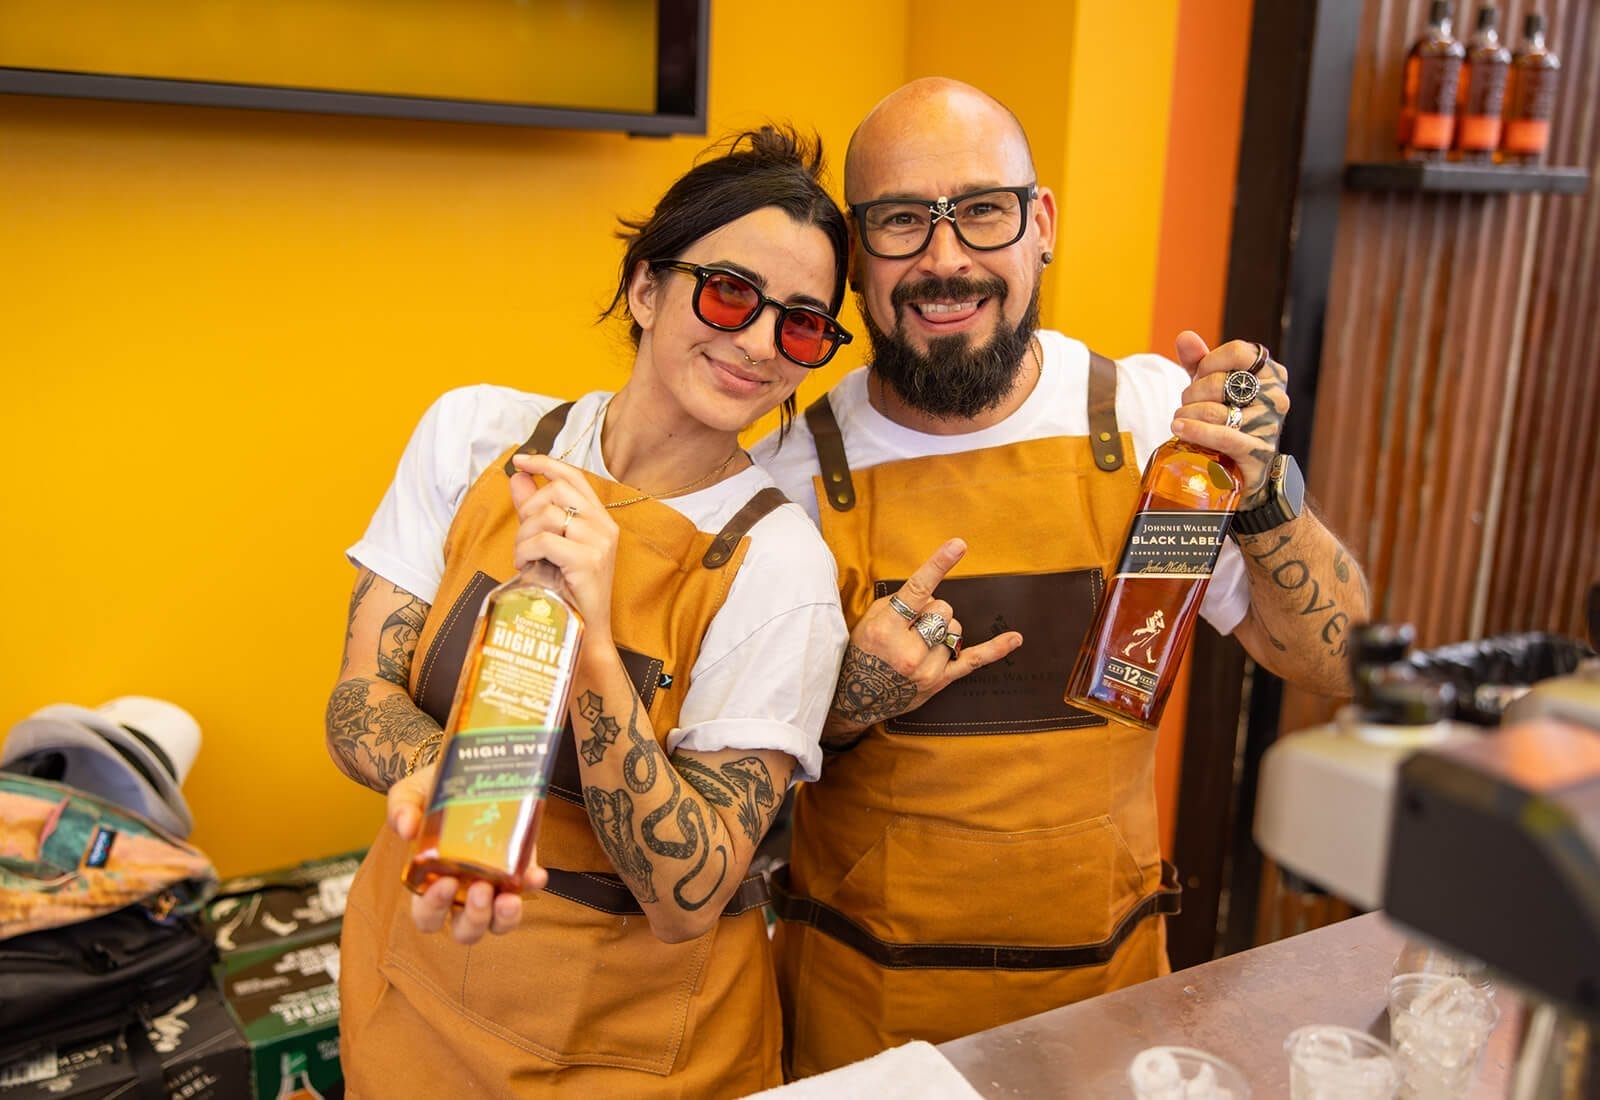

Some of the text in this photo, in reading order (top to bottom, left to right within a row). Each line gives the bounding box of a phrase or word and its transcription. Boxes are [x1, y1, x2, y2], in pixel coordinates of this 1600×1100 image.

[1143, 524, 1220, 533] JOHNNIE WALKER
[1132, 536, 1223, 546] BLACK LABEL
[492, 626, 537, 658] HIGH
[1123, 666, 1141, 685] 12
[458, 742, 549, 761] HIGH RYE
